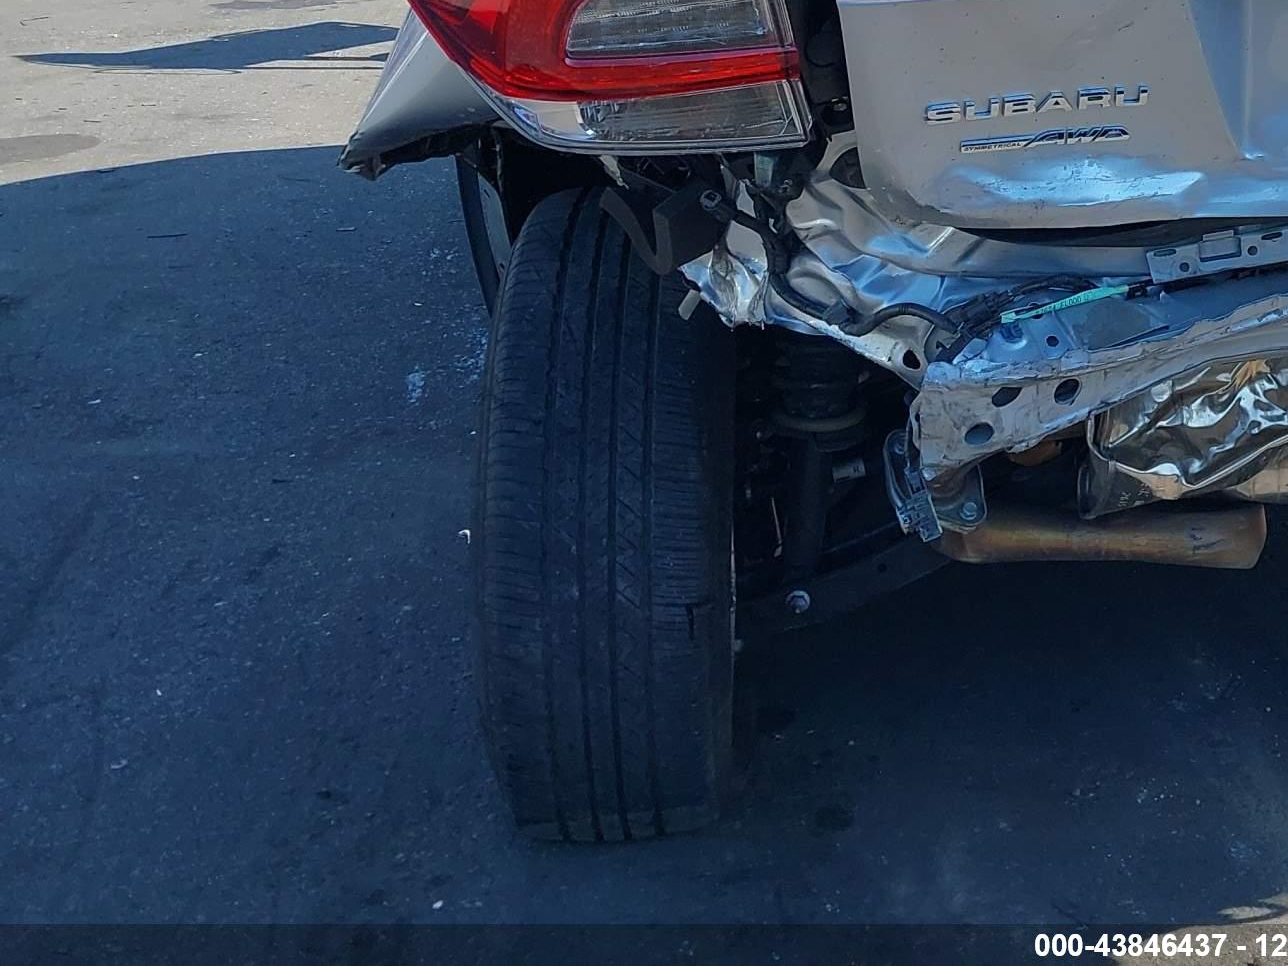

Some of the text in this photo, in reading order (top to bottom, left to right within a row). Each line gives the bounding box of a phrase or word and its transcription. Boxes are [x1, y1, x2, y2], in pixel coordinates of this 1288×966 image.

[924, 85, 1148, 126] SUBARU
[963, 125, 1130, 152] SYMMETRICAL AWD
